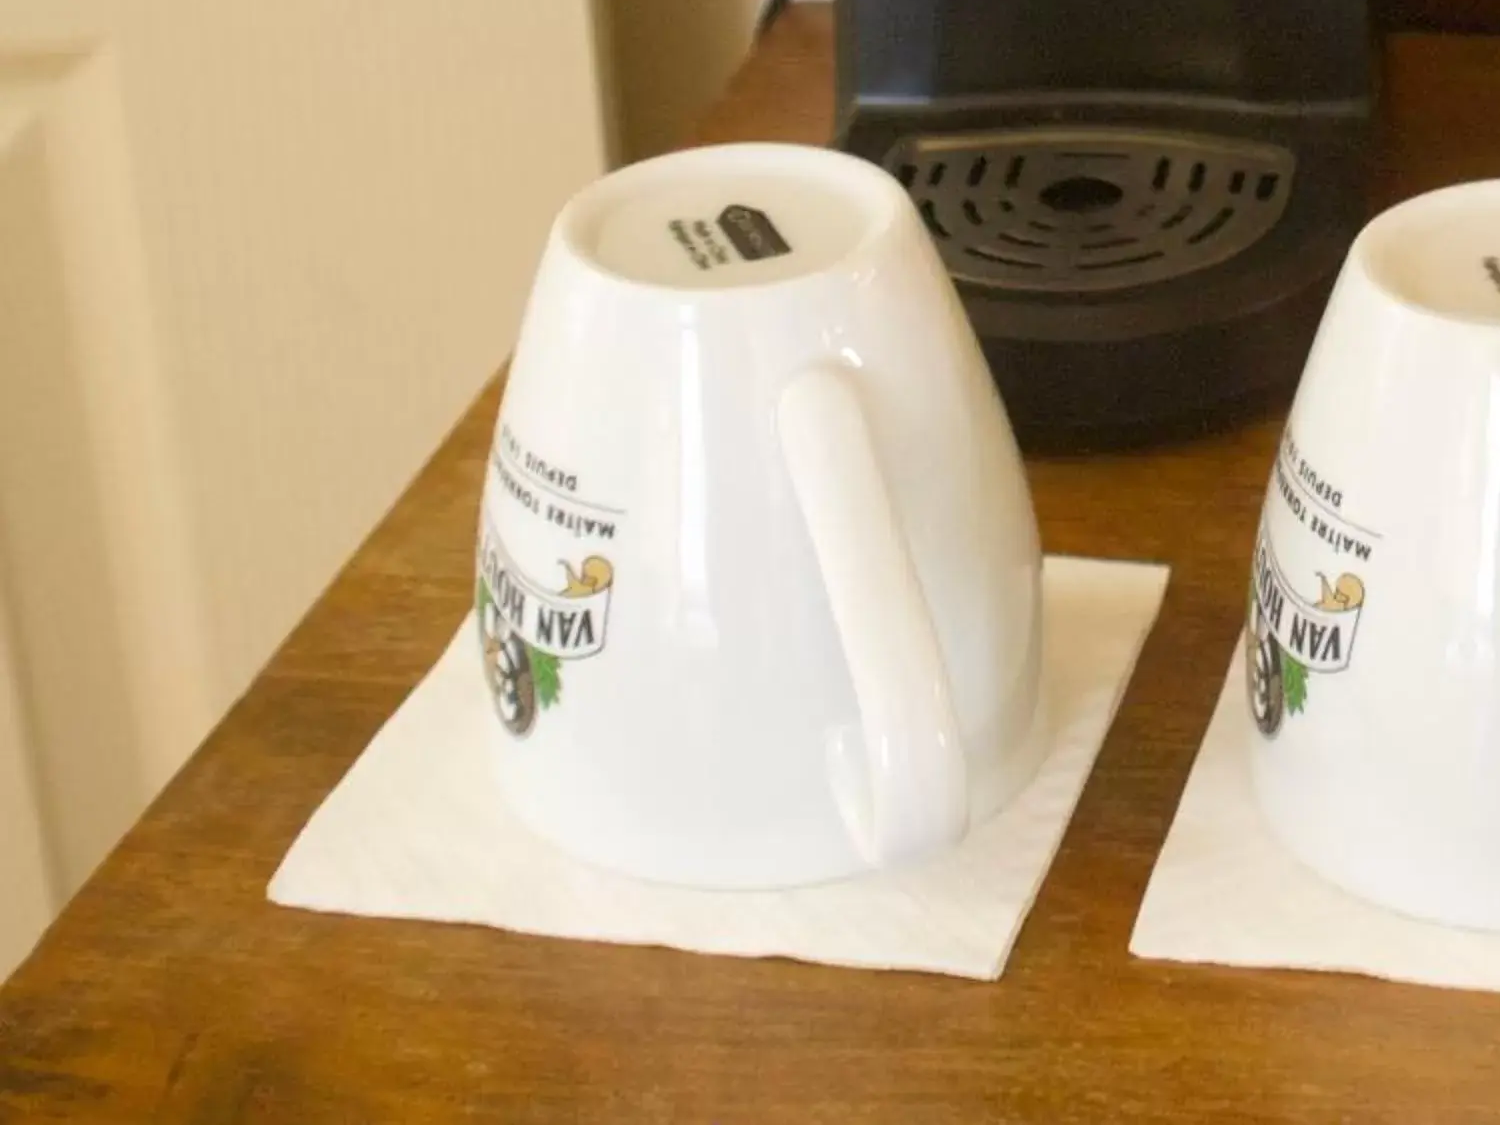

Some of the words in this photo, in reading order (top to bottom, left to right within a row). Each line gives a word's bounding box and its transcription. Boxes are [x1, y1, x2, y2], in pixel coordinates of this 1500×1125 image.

[525, 451, 577, 491] DEPUIS
[1299, 458, 1343, 508] DEPUIS
[546, 502, 615, 539] MAÎTRE
[1309, 513, 1372, 562] MAÎTRE
[536, 606, 594, 649] VAN
[1289, 612, 1341, 662] VAN
